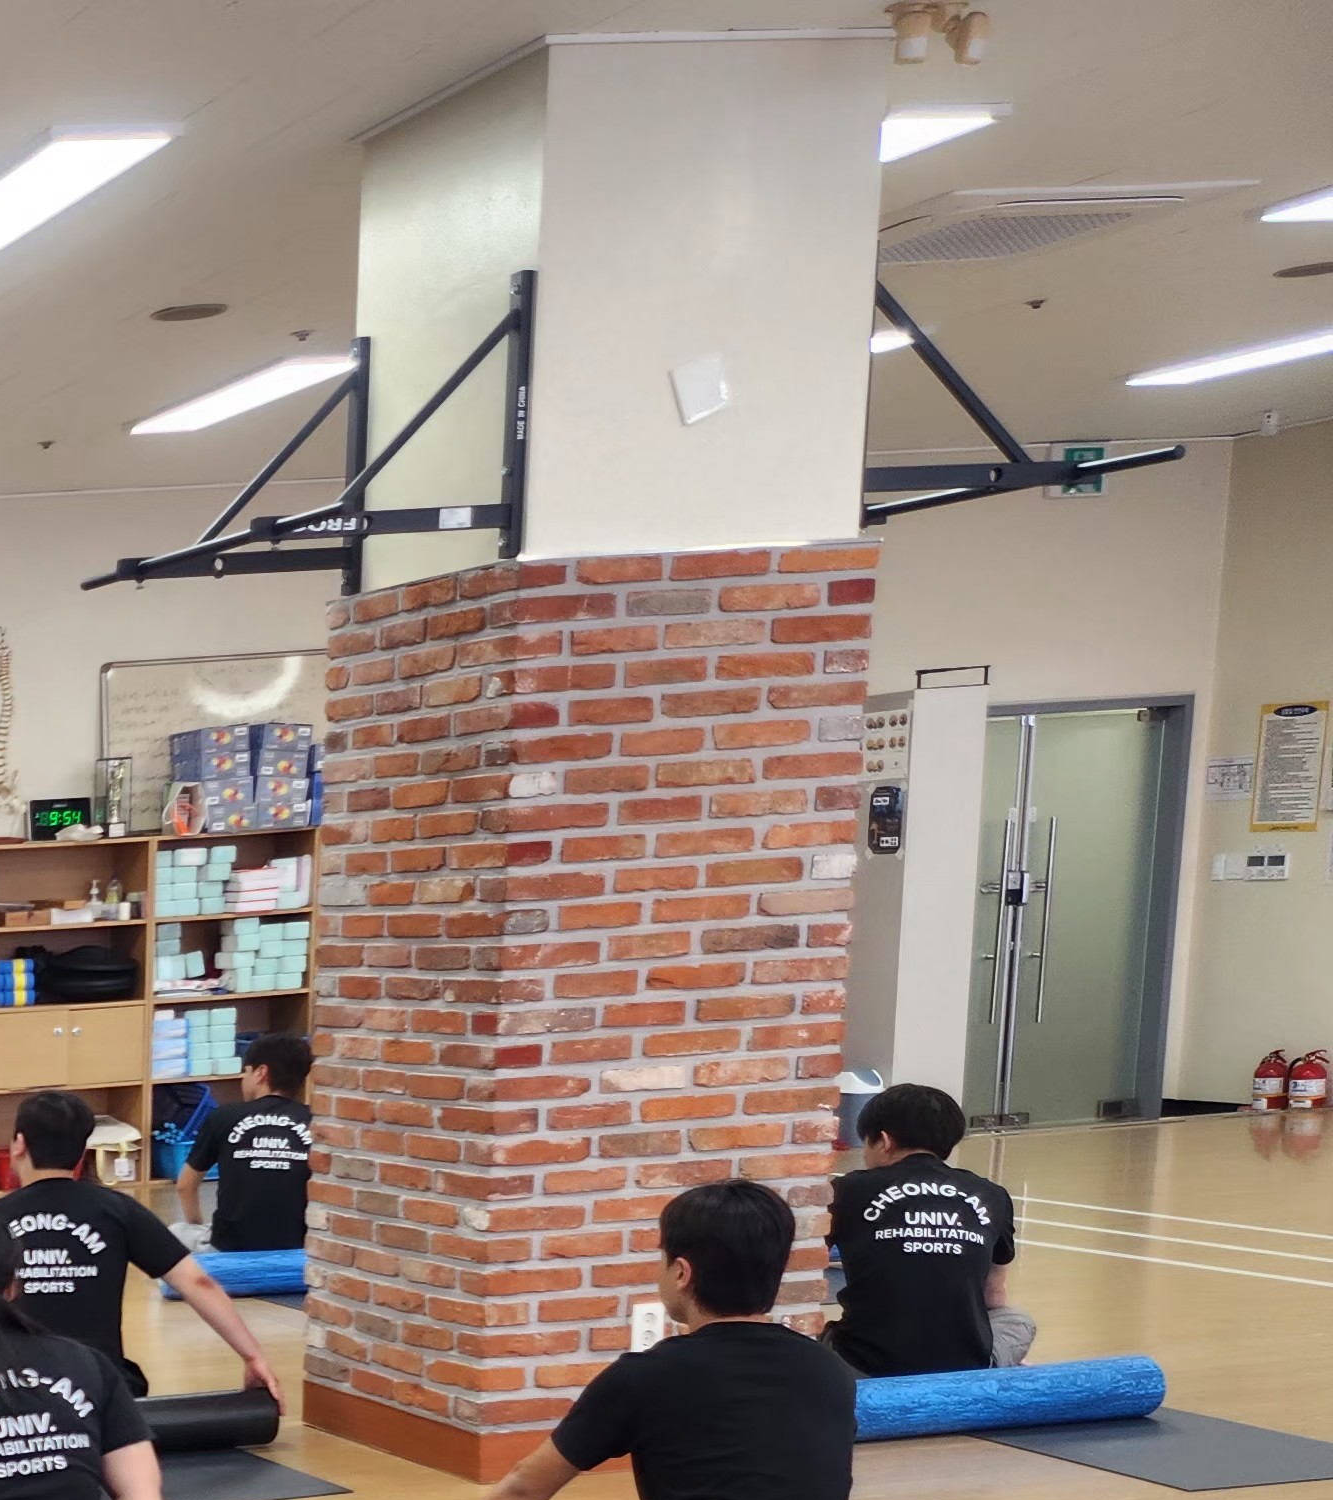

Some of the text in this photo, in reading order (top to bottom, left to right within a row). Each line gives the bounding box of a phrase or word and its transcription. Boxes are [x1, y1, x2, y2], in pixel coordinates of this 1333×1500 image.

[228, 1114, 313, 1145] CHEONG-AM
[252, 1137, 291, 1149] UNIV.
[863, 1182, 991, 1226] CHEONG-AM
[905, 1211, 962, 1226] UNIV.
[875, 1228, 984, 1245] REHABILITATION
[903, 1241, 962, 1255] SPORTS
[23, 1248, 72, 1265] UNIV.
[23, 1281, 75, 1293] SPORTS
